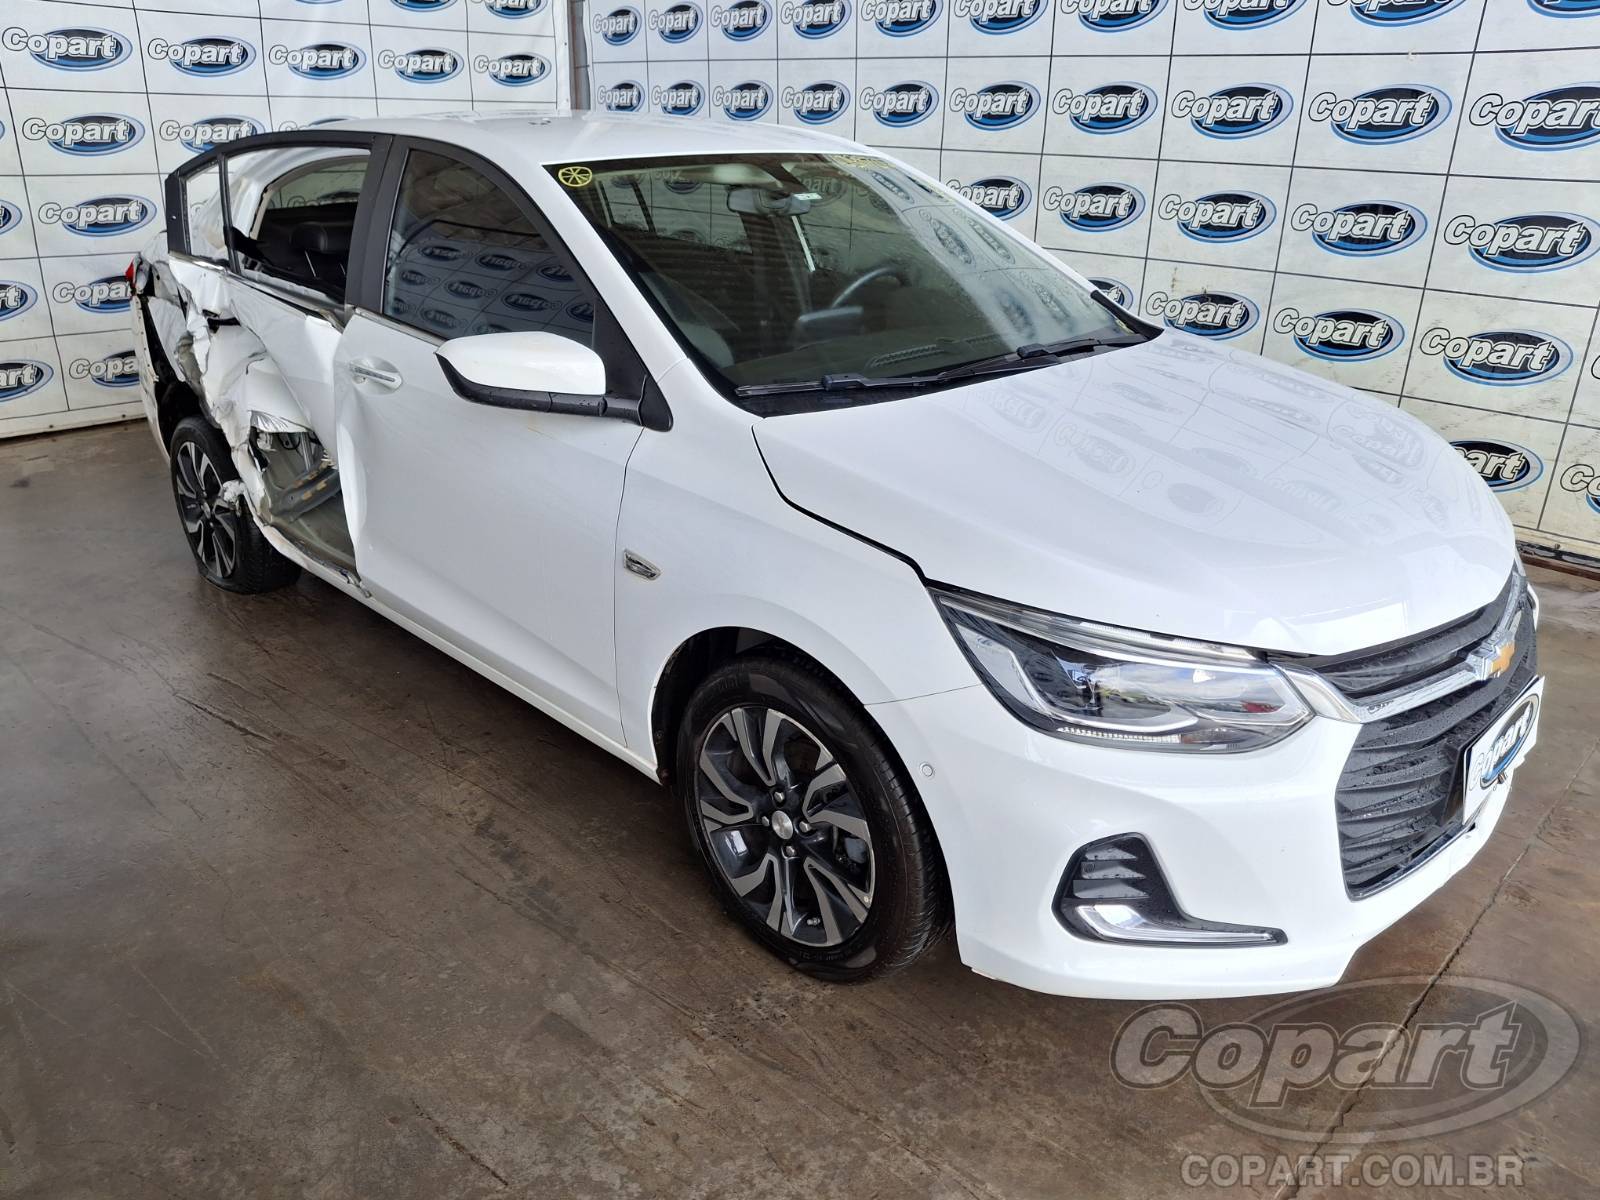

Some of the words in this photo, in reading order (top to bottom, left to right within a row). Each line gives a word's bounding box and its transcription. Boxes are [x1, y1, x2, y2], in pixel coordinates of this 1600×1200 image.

[593, 9, 635, 37] Copart
[649, 7, 698, 34] Copart
[711, 2, 766, 32] Copart
[781, 1, 846, 30] Copart
[861, 0, 937, 27] Copart
[954, 0, 1041, 25] Copart
[2, 27, 117, 60] Copart
[148, 38, 242, 66] Copart
[269, 44, 353, 70] Copart
[378, 50, 453, 75] Copart
[474, 55, 541, 77] Copart
[597, 84, 639, 110] Copart
[651, 83, 700, 112] Copart
[712, 85, 766, 114] Copart
[781, 86, 844, 115] Copart
[860, 86, 929, 117] Copart
[949, 88, 1030, 120] Copart
[1052, 88, 1146, 122] Copart
[1171, 90, 1279, 126] Copart
[1309, 91, 1435, 130] Copart
[22, 118, 129, 146] Copart
[159, 120, 252, 147] Copart
[38, 201, 142, 229] Copart
[1043, 186, 1133, 220] Copart
[1158, 193, 1265, 228] Copart
[1290, 203, 1412, 241] Copart
[1444, 214, 1587, 257] Copart
[53, 281, 132, 307] Copa
[1146, 291, 1248, 328] Copart
[1272, 307, 1390, 349] Copart
[1420, 328, 1555, 371] Copart
[69, 358, 138, 381] Copa
